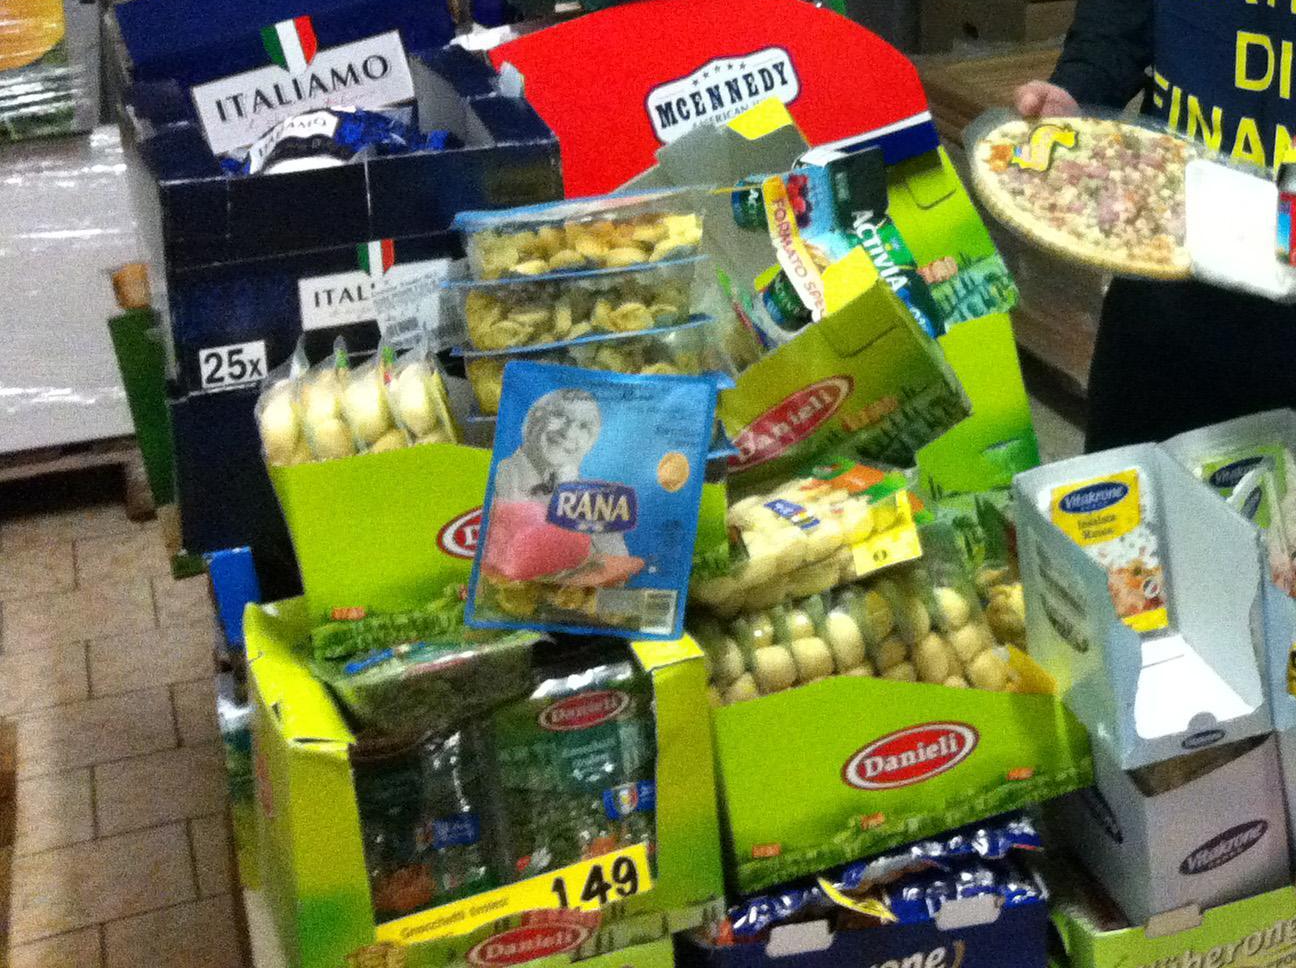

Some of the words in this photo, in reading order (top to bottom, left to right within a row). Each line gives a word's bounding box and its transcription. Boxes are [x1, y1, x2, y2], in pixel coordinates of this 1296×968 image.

[215, 54, 389, 122] ITALIAMO
[1234, 30, 1293, 99] DI
[655, 61, 788, 129] MCENNEDY
[851, 210, 908, 292] ACTIVIA
[203, 348, 263, 384] 25x
[556, 491, 631, 522] RANA
[862, 731, 960, 779] Danieli
[486, 931, 576, 959] Danieli
